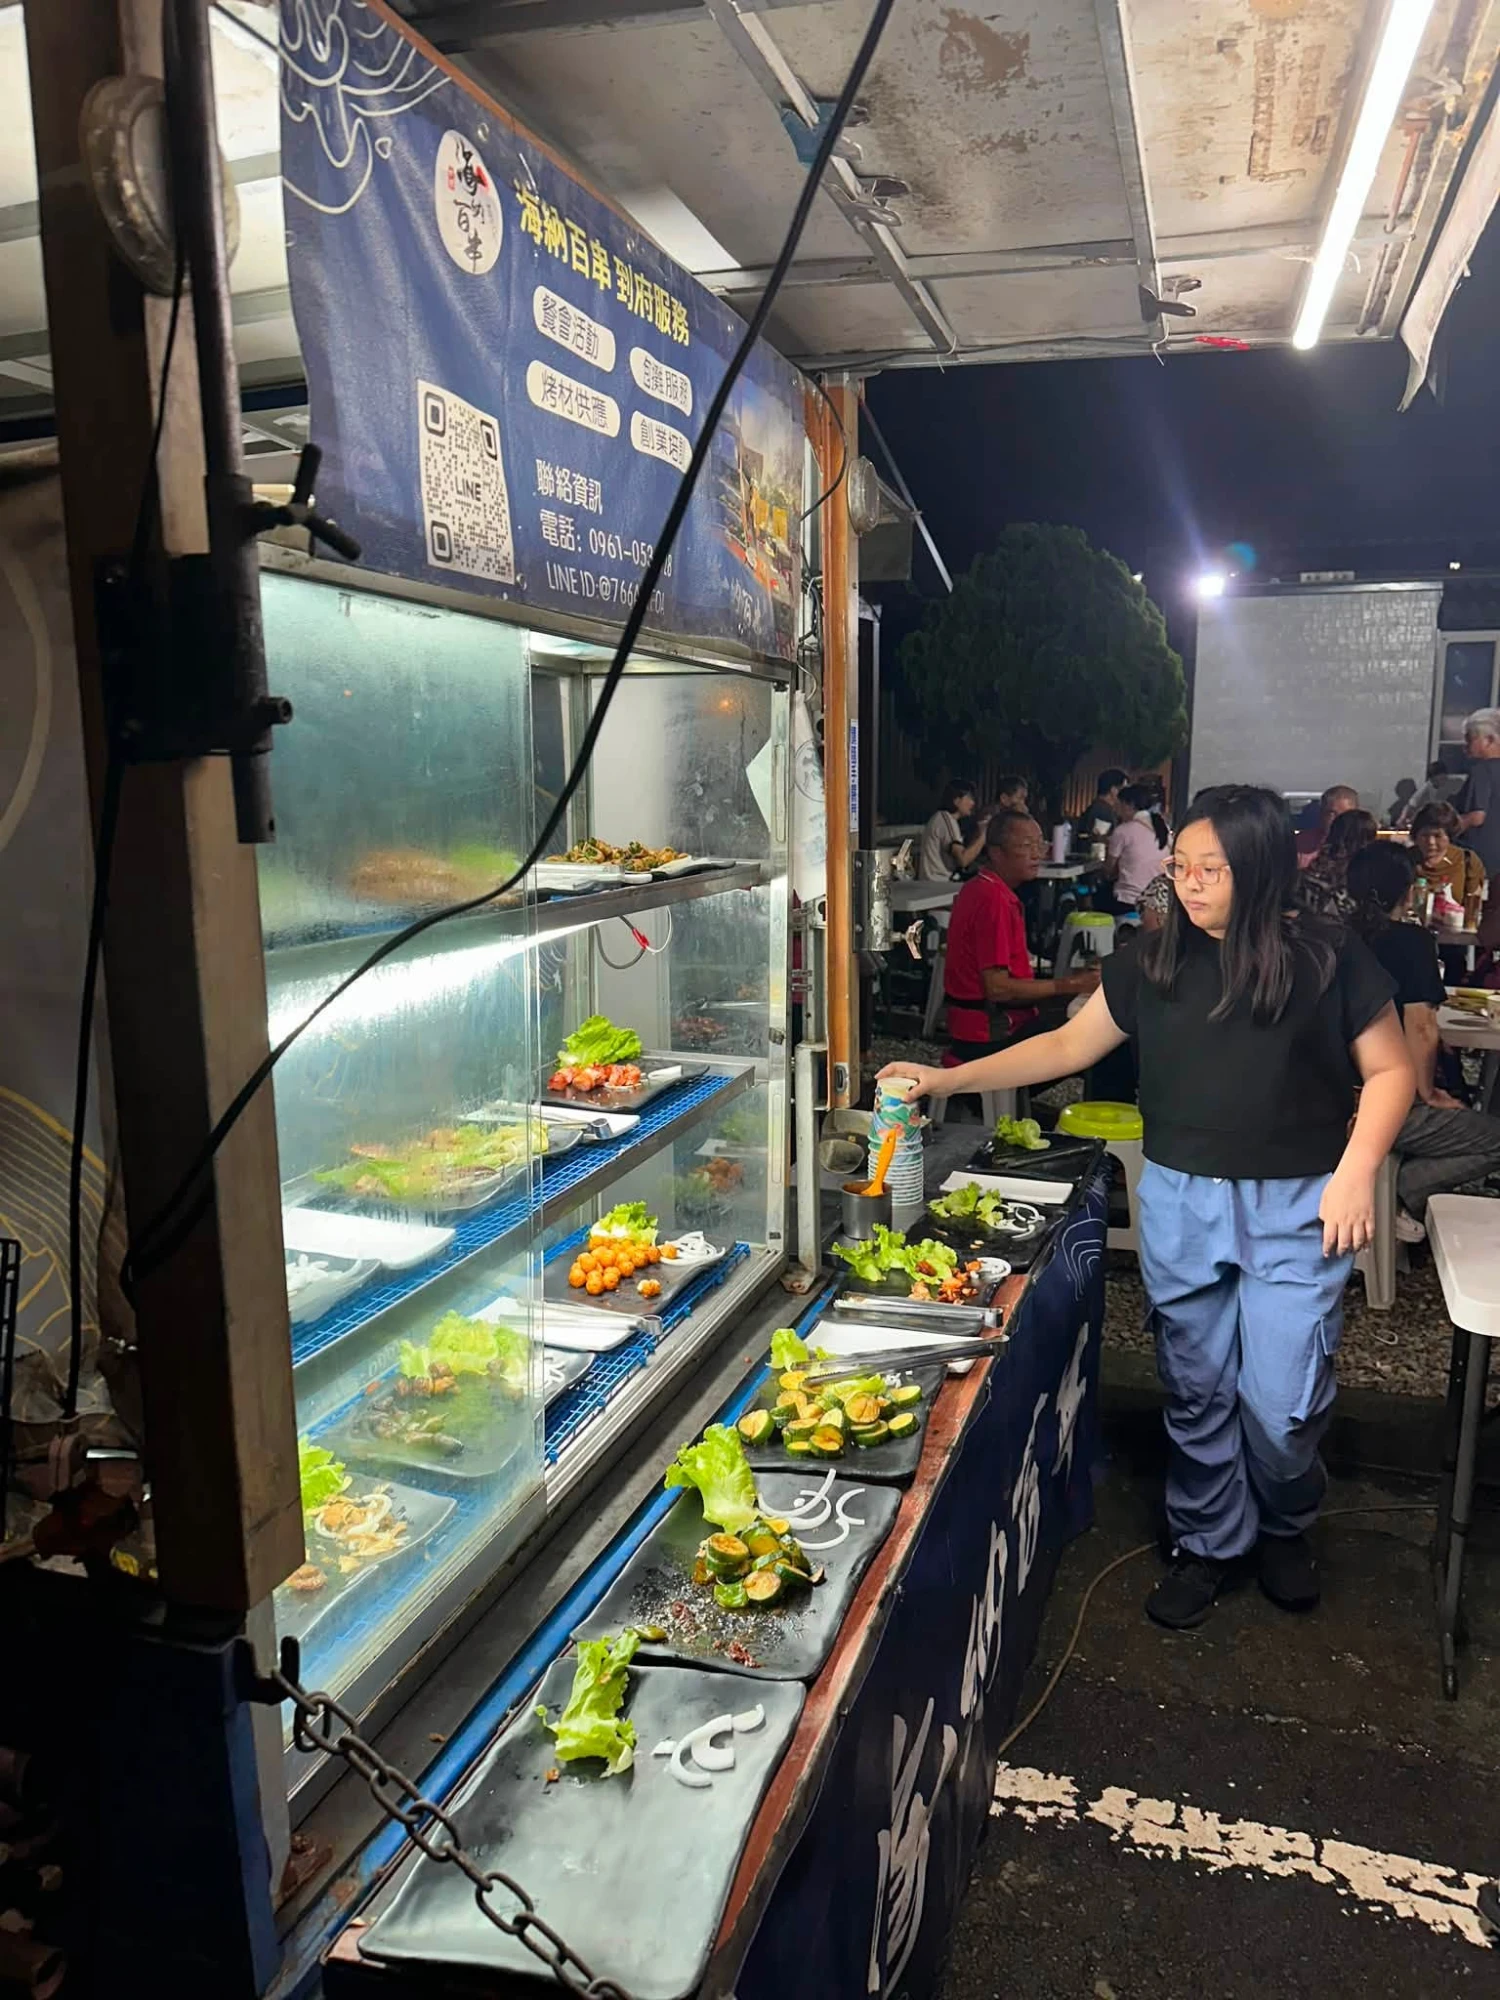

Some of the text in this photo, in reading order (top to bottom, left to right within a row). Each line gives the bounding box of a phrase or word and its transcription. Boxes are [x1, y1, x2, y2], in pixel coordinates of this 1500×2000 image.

[514, 180, 690, 347] 海納百串 到府服務
[541, 293, 598, 361] 餐會活動
[540, 368, 609, 430] 烤材供應
[454, 475, 482, 502] LINE
[535, 458, 604, 516] 聯絡資訊
[546, 560, 579, 595] LINE
[589, 527, 673, 577] 0961-05328
